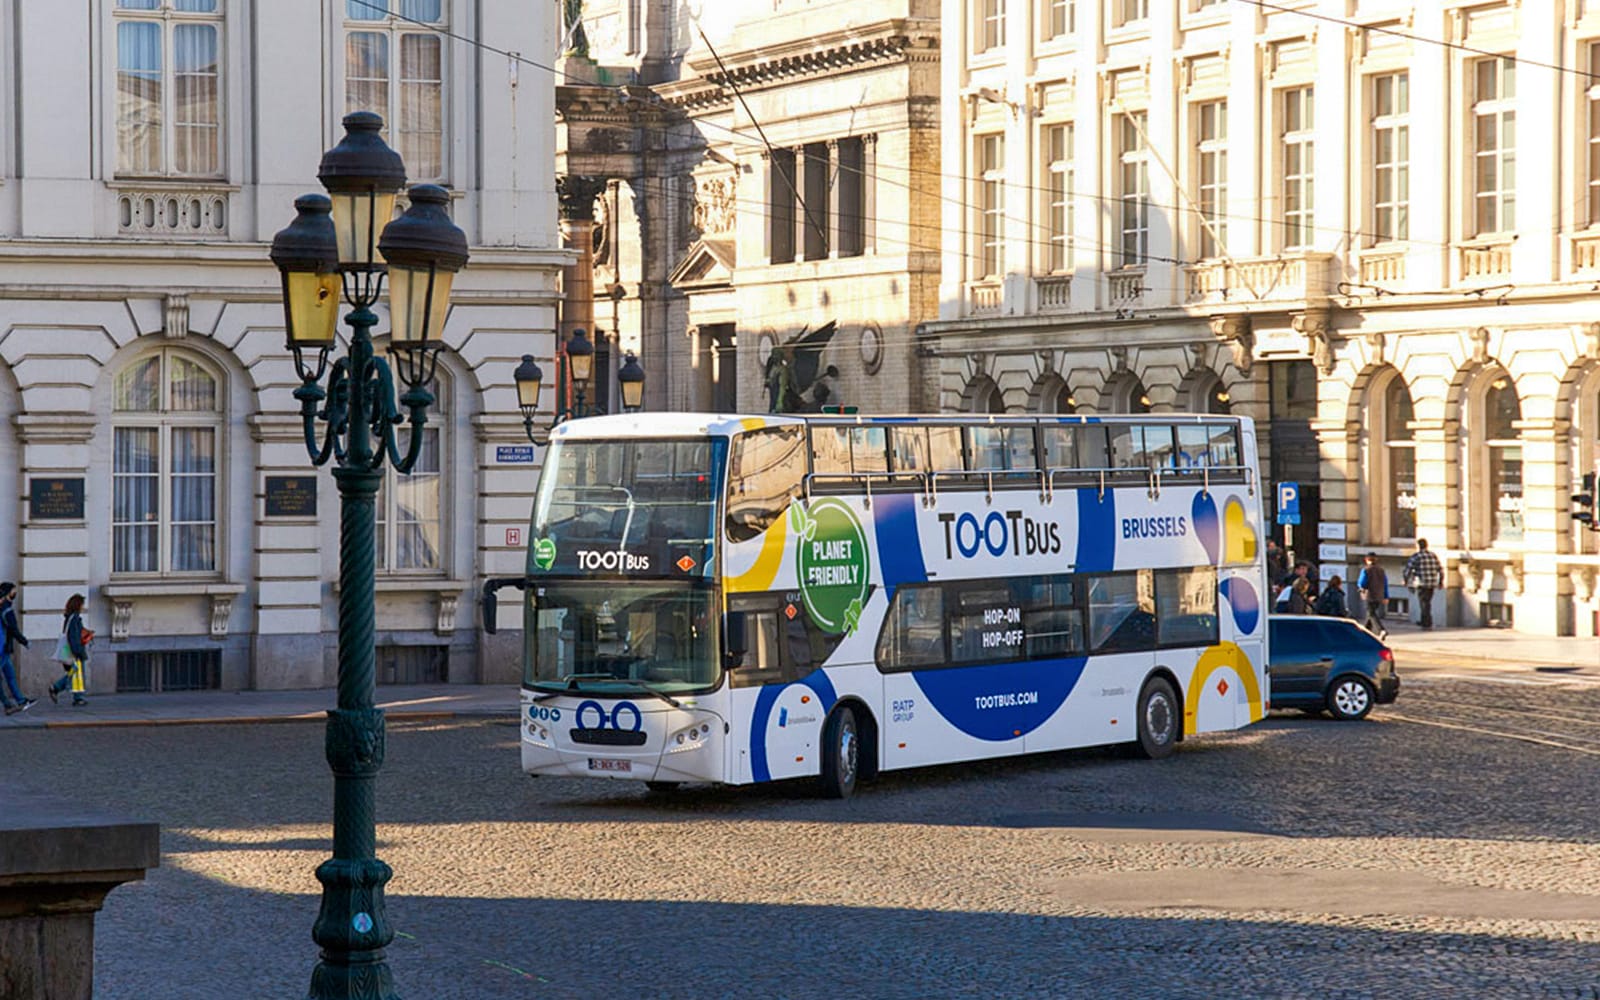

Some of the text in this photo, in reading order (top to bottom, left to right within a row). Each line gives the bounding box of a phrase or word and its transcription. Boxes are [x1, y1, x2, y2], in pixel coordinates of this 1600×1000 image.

[1281, 487, 1297, 510] P
[509, 530, 517, 542] H
[1122, 516, 1187, 539] BRUSSELS
[812, 540, 852, 561] PLANET
[808, 564, 859, 587] FRIENDLY
[983, 607, 1021, 625] HOP-ON
[982, 630, 1024, 648] HOP-OFF
[892, 699, 914, 712] RATP
[975, 691, 1038, 710] TOOTBUS.COM
